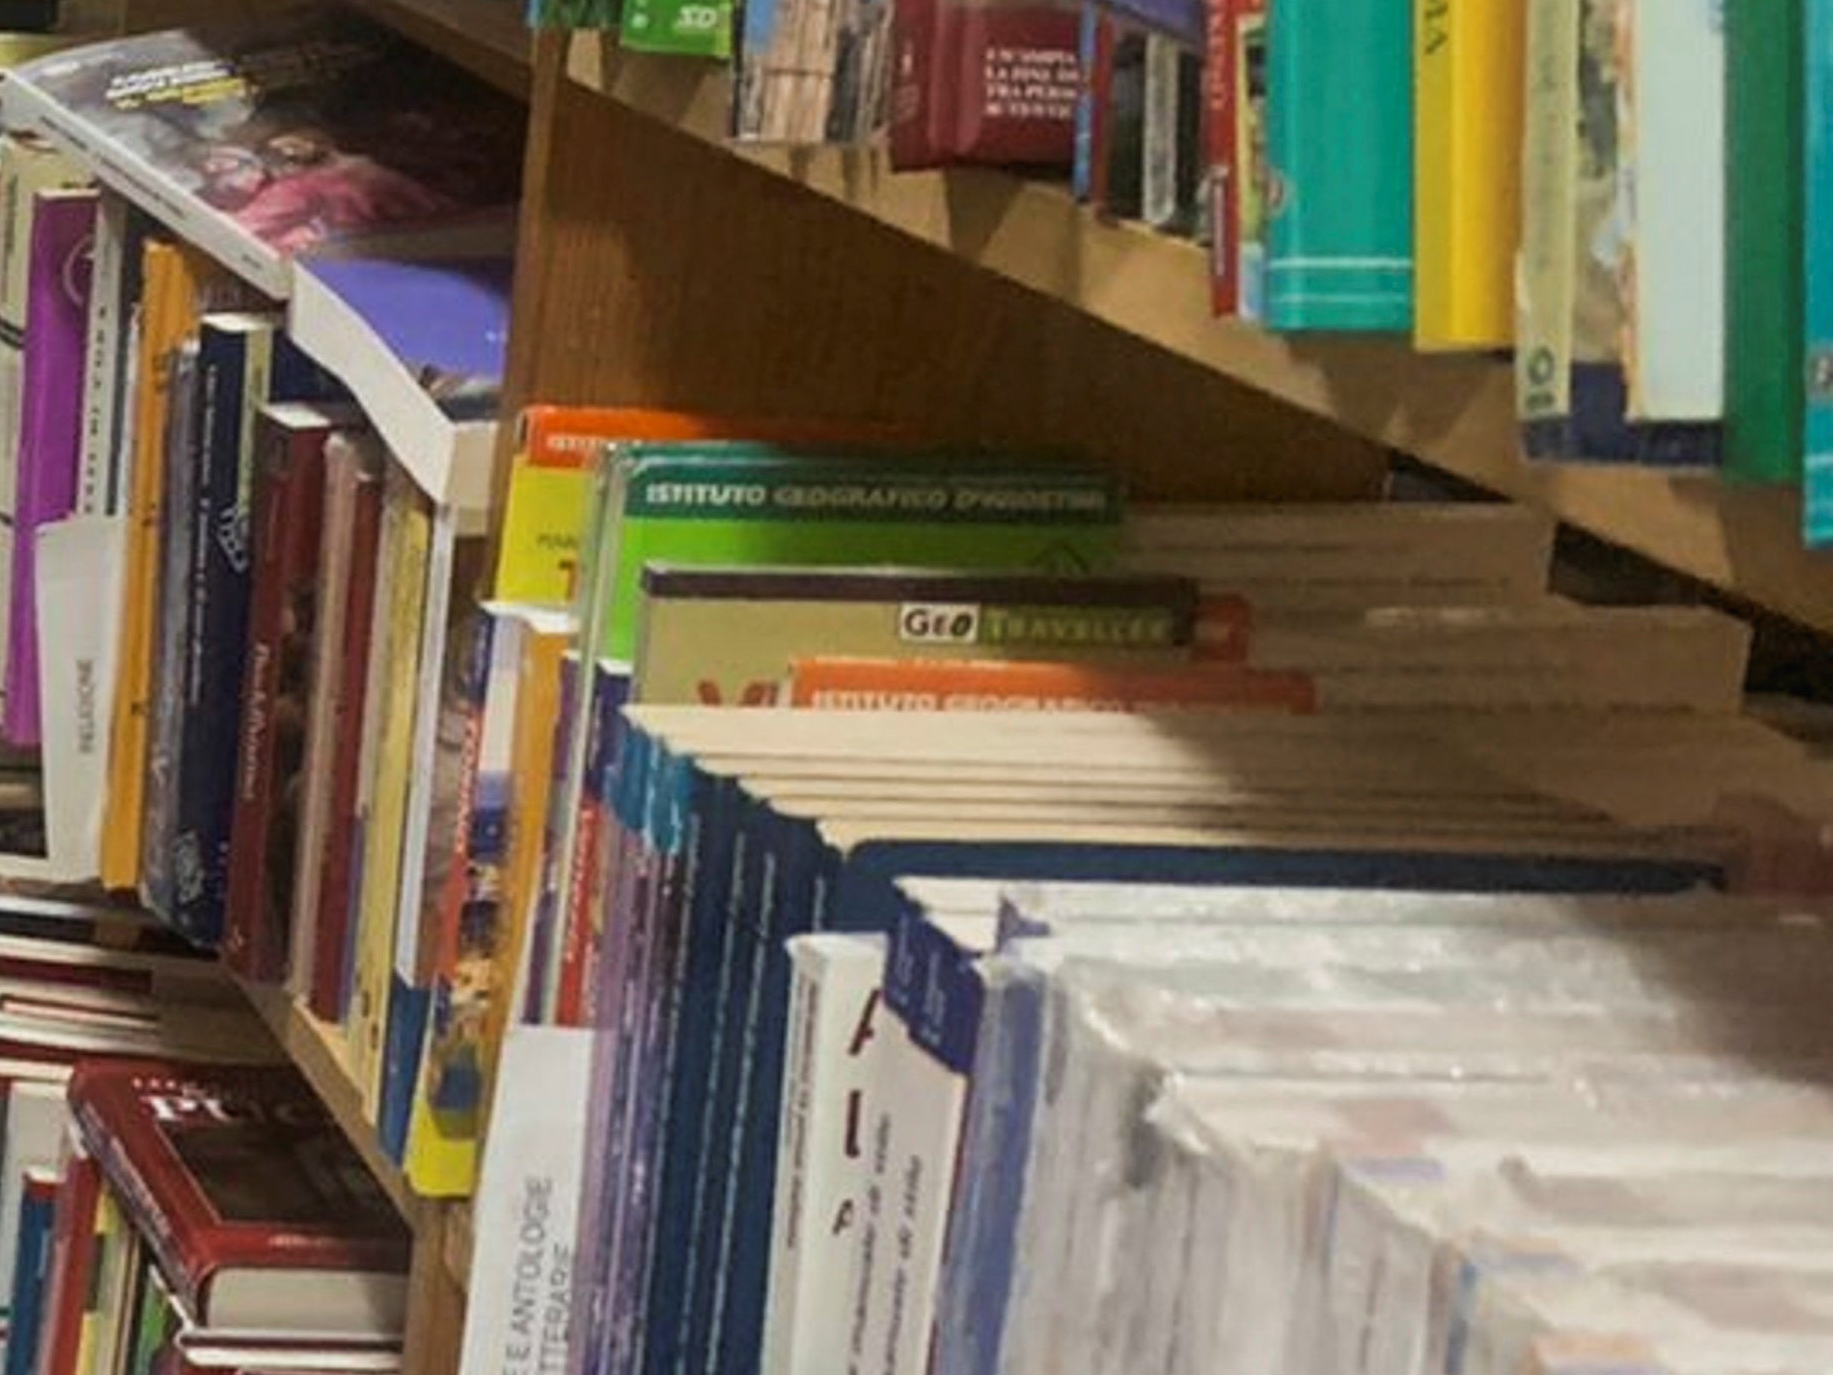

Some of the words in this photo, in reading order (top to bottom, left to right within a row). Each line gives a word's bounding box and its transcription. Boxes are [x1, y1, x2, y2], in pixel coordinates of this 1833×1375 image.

[647, 483, 766, 507] ISTITUTO
[774, 485, 946, 510] GEOGRAFICO
[509, 1176, 552, 1336] ANTOLOGIE
